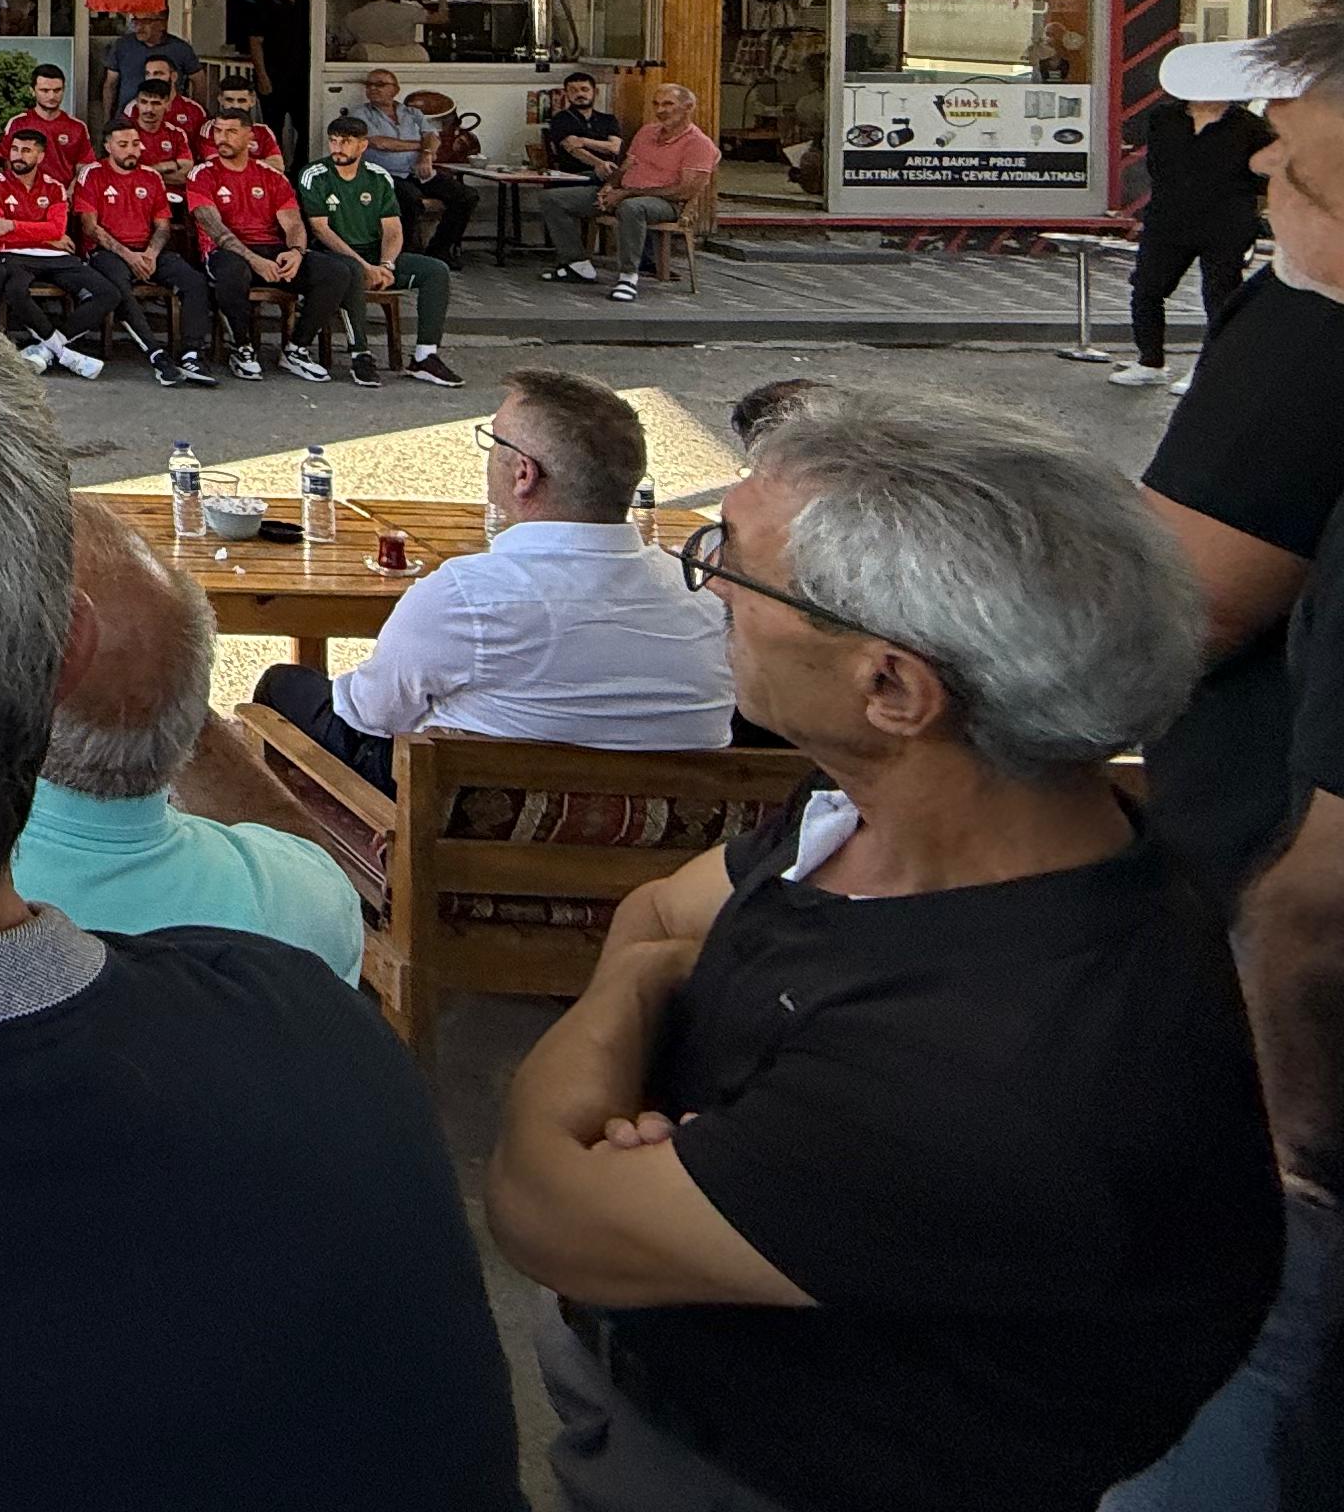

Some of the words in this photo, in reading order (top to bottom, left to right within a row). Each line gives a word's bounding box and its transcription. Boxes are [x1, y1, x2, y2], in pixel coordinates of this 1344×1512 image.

[905, 156, 940, 167] ARIZA
[942, 156, 980, 167] BAKIM
[989, 156, 1027, 167] PROJE
[844, 168, 900, 180] ELEKTRİK
[901, 168, 952, 180] TESİSATI
[961, 170, 999, 182] ÇEVRE
[1000, 171, 1087, 182] AYDINLATMASI
